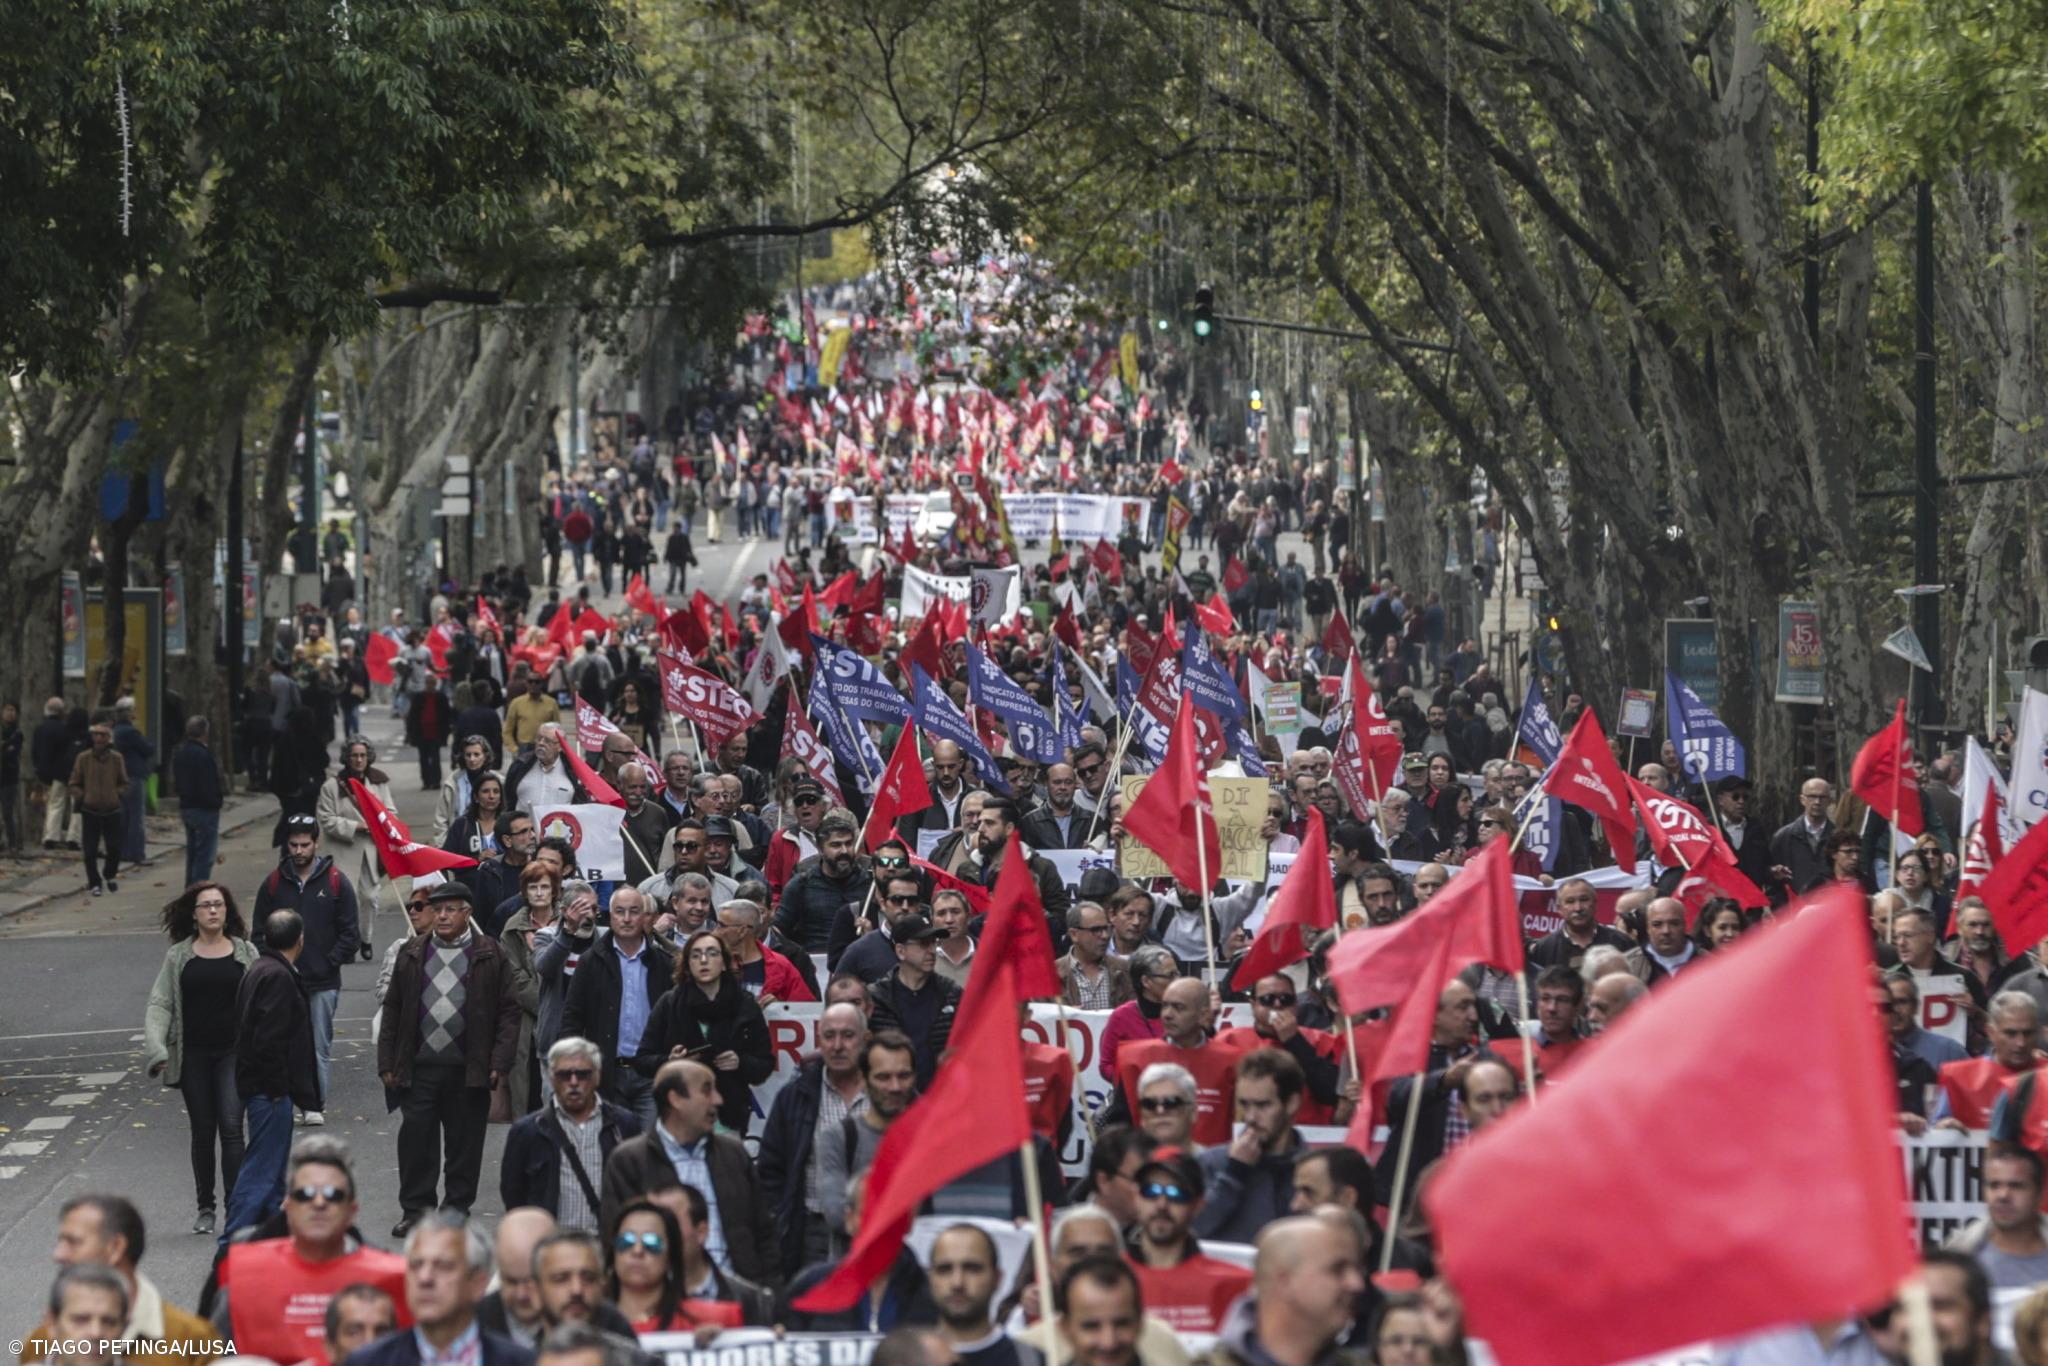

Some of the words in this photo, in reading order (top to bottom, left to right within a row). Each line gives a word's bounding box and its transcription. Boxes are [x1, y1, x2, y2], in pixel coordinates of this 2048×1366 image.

[1794, 624, 1813, 643] 15
[1185, 666, 1219, 687] SINDICATO
[843, 685, 859, 694] DOS
[981, 683, 1015, 699] SINDICATO
[1182, 678, 1194, 690] DAS
[1196, 686, 1231, 704] EMPRESAS
[861, 698, 872, 708] DO
[874, 702, 900, 715] GRUPO
[995, 698, 1033, 714] EMPRESAS
[925, 713, 939, 725] DAS
